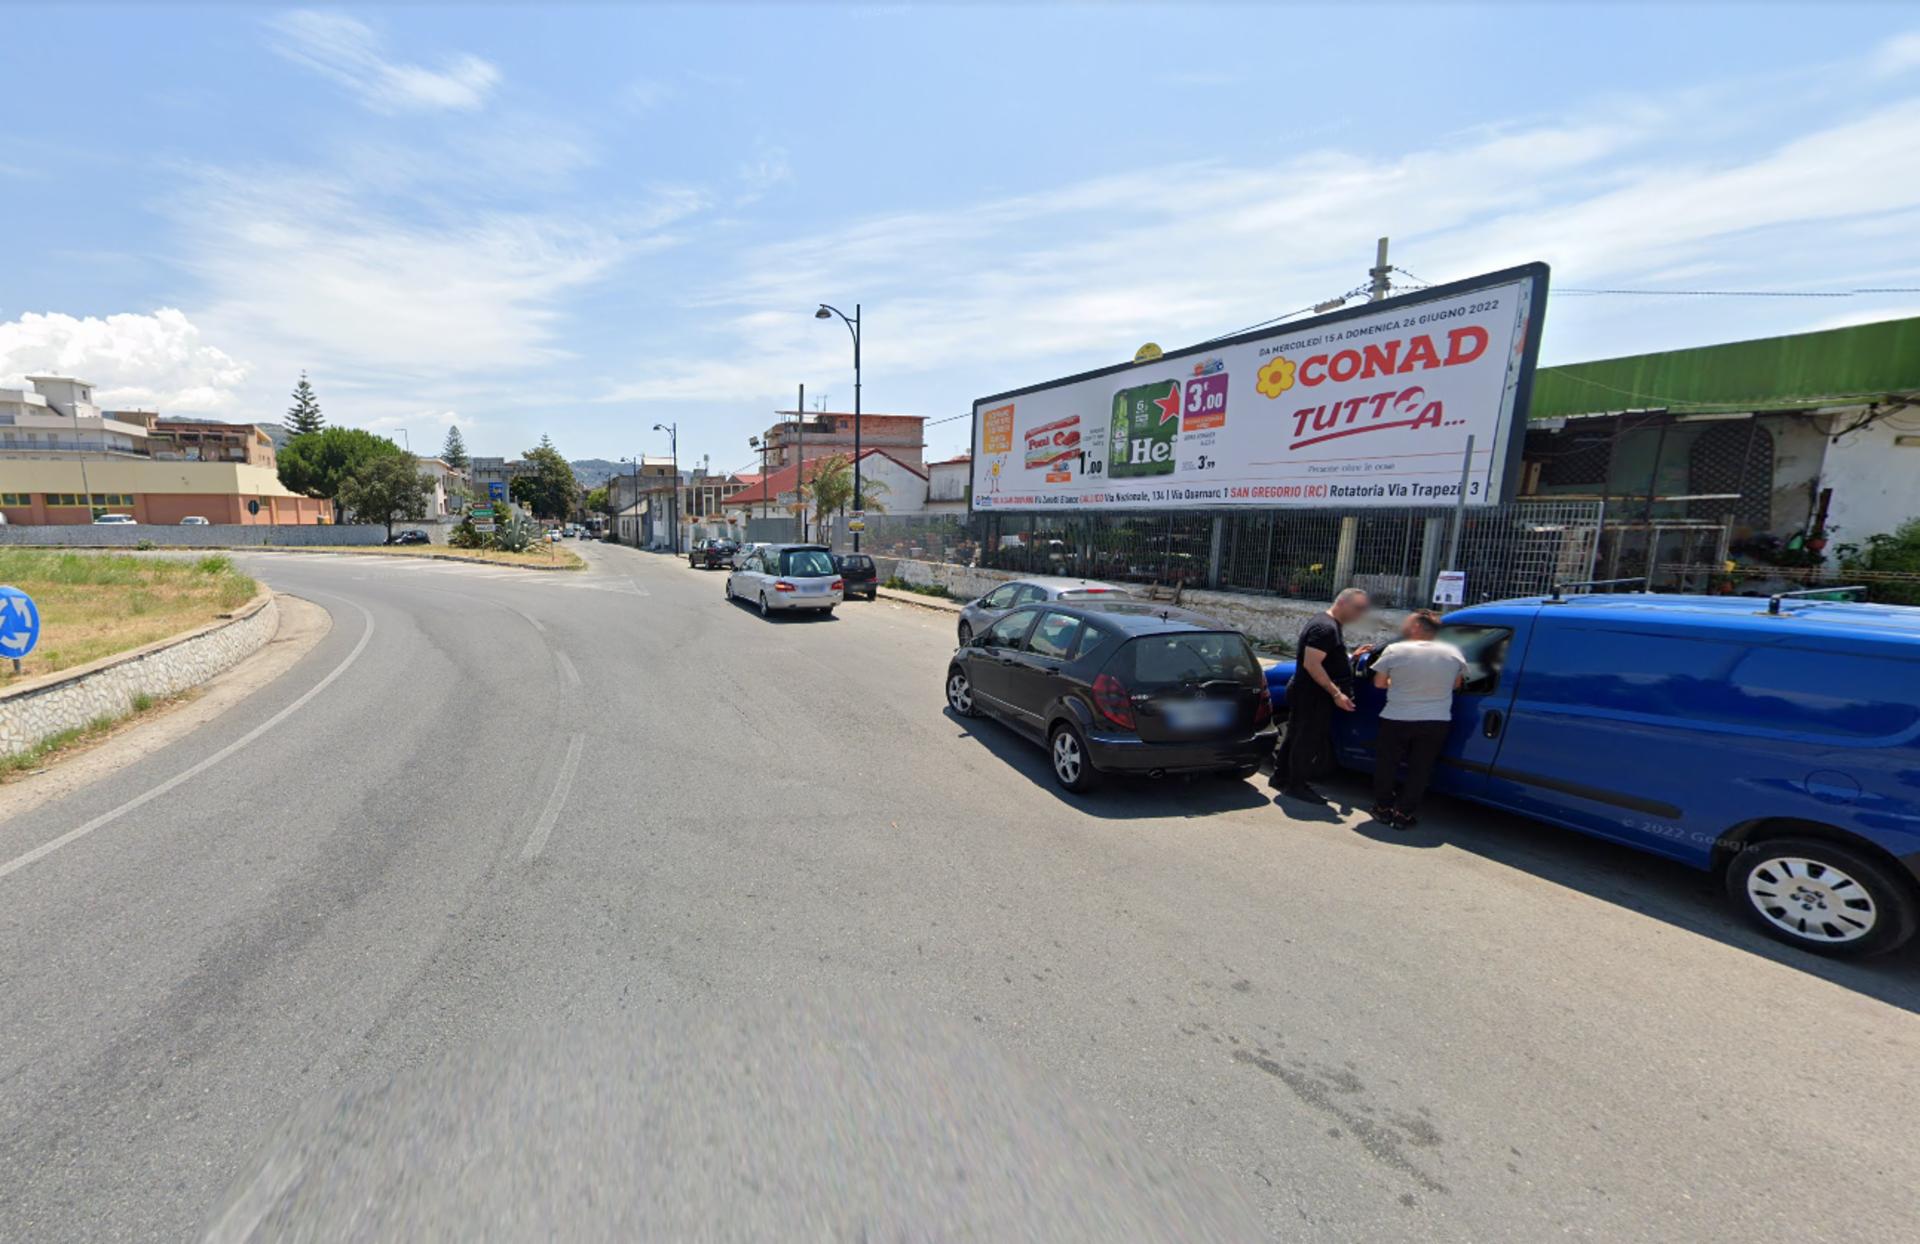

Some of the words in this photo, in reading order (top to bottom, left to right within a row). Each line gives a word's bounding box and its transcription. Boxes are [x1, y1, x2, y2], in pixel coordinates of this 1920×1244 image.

[1259, 347, 1272, 357] DA
[1324, 333, 1335, 343] 15
[1335, 332, 1344, 342] A
[1346, 322, 1401, 340] DOMENICA
[1403, 318, 1416, 329] 26
[1419, 307, 1467, 326] GIUGNO
[1469, 300, 1499, 315] 2022
[1298, 325, 1489, 387] CONAD
[1171, 488, 1183, 500] Via
[1230, 486, 1249, 499] SAN
[1251, 485, 1301, 498] GREGORIO
[1303, 484, 1328, 499] (RC)
[1330, 484, 1385, 497] Rotatoria
[1388, 483, 1407, 497] Via
[1470, 481, 1480, 496] 3
